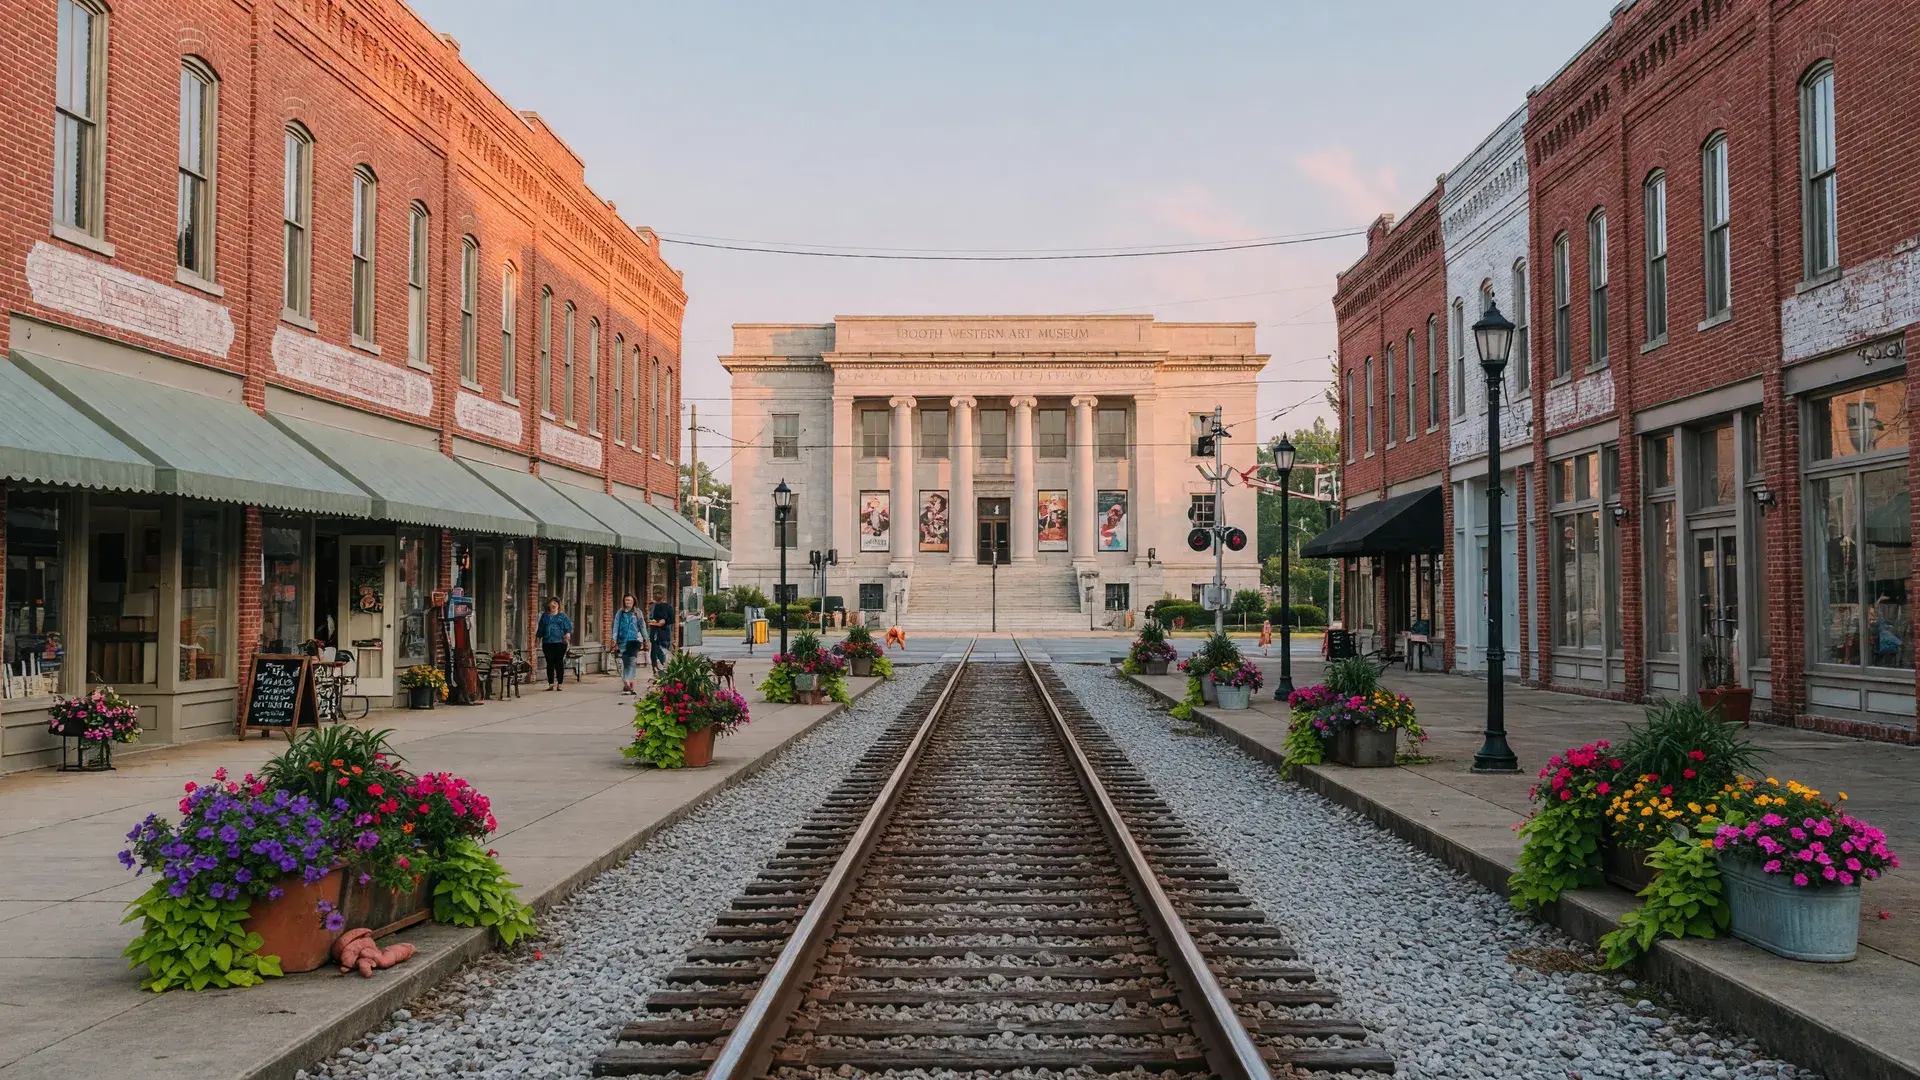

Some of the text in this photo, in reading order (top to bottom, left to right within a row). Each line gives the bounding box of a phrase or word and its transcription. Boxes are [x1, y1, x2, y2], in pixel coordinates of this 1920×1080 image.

[900, 328, 1089, 339] BOOTH WESTERN ART MUSEUM
